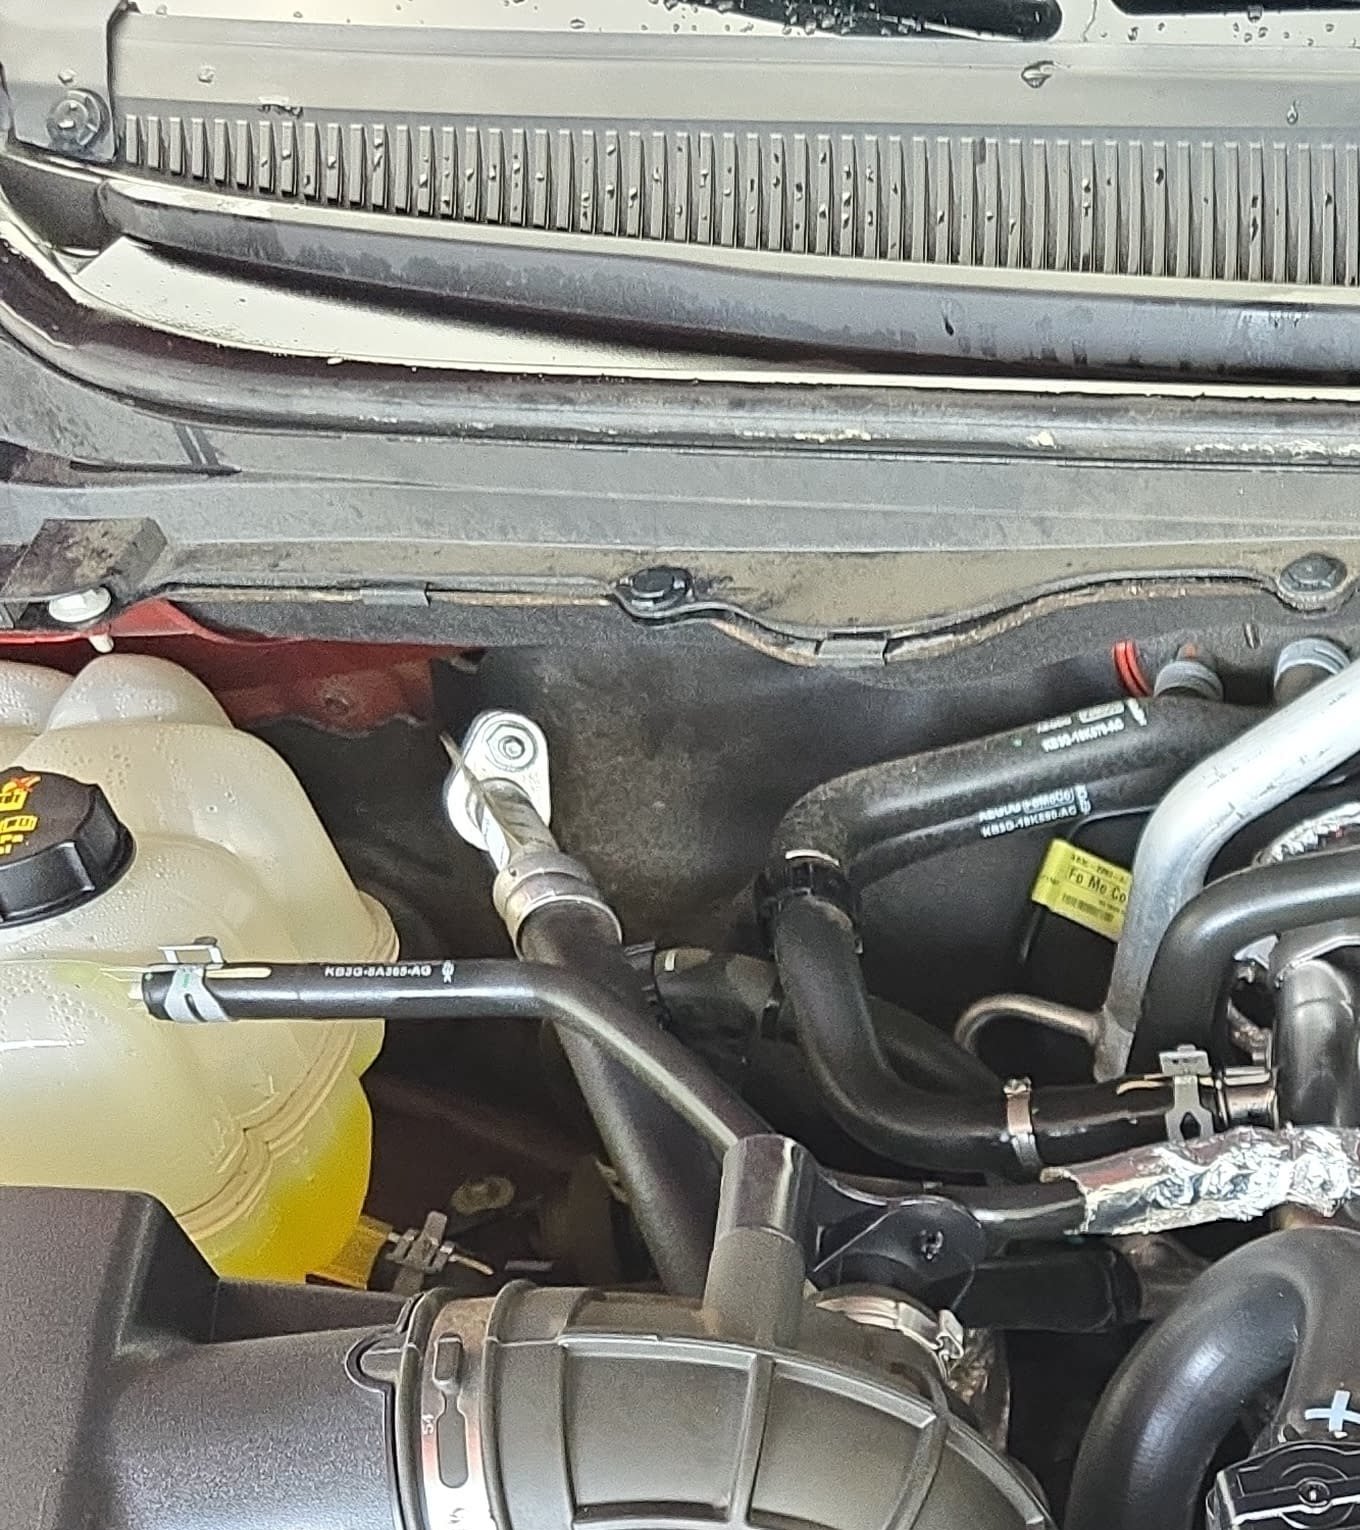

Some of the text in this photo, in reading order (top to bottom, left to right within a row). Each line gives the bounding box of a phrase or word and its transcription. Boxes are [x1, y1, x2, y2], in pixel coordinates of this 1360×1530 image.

[1068, 867, 1084, 884] Fo
[1088, 875, 1108, 895] Mo
[1112, 886, 1127, 903] Co
